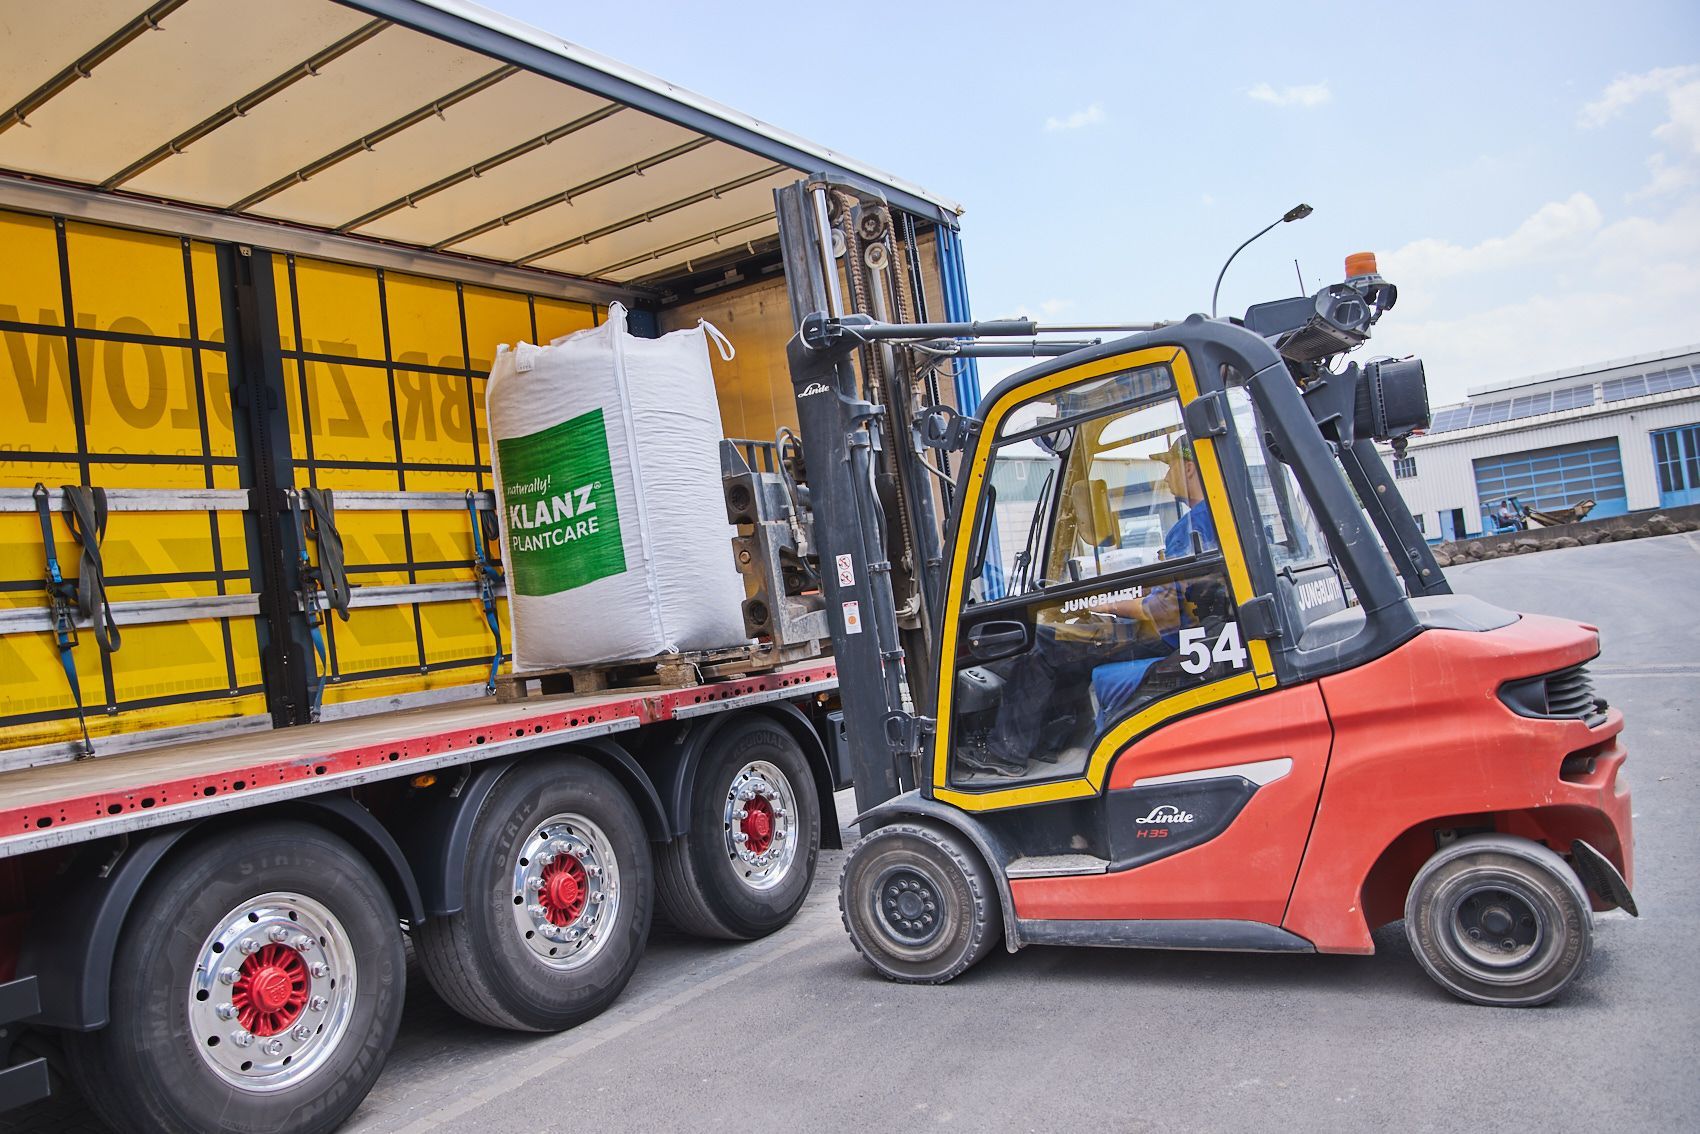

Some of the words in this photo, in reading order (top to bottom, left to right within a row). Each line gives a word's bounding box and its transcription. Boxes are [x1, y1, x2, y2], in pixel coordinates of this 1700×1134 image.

[797, 382, 830, 398] Linde
[507, 474, 551, 496] naturally!
[512, 516, 600, 552] PLANTCARE
[1060, 585, 1142, 614] JUNGBLUTH
[1178, 621, 1248, 675] 54
[1135, 805, 1194, 824] Linde
